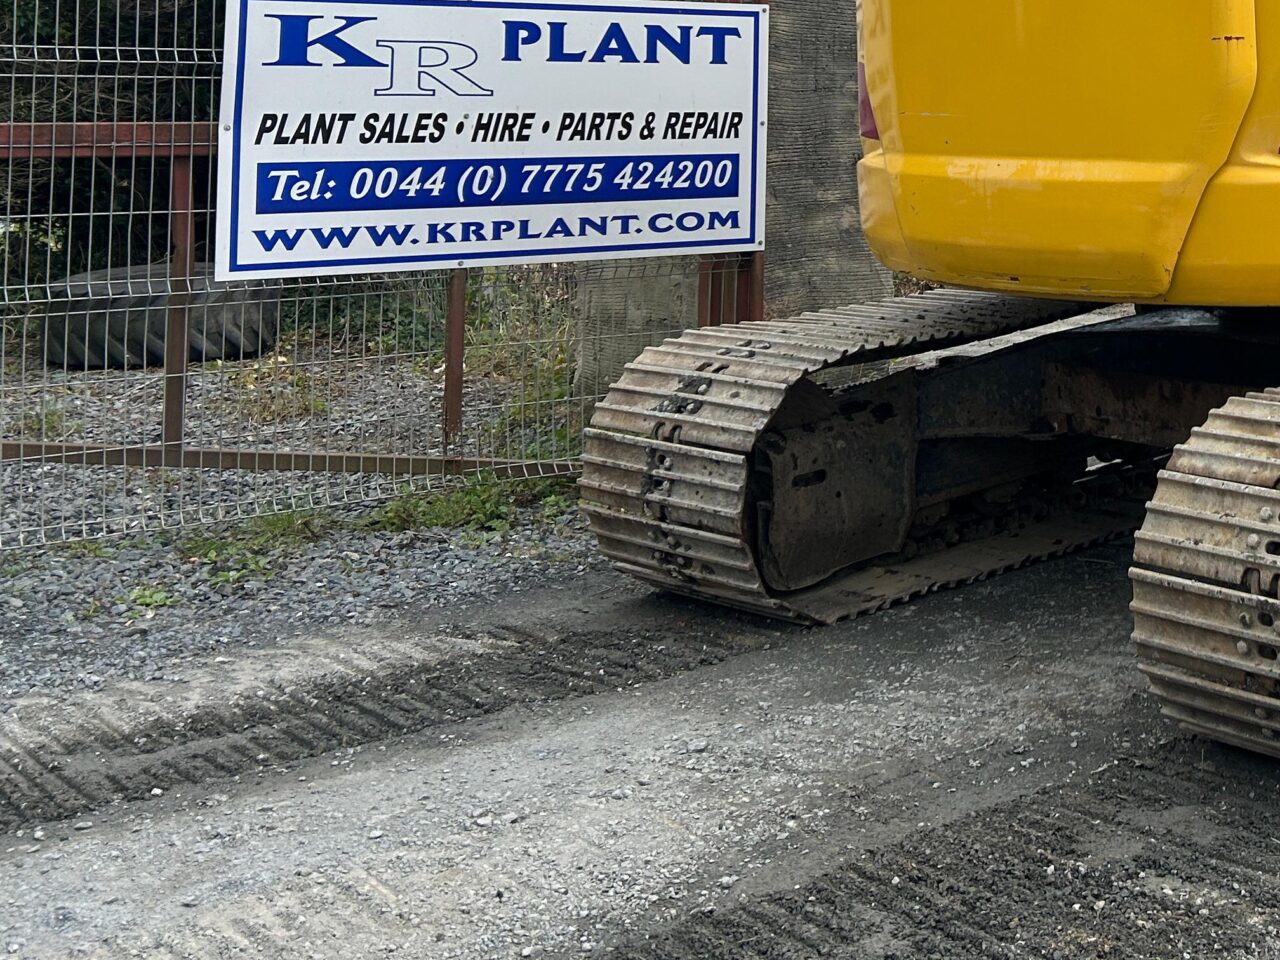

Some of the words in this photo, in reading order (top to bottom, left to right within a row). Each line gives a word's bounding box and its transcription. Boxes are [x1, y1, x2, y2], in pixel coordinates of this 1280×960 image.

[261, 13, 494, 96] KR
[502, 20, 741, 65] PLANT
[254, 113, 355, 145] PLANT
[359, 112, 448, 144] SALES
[471, 112, 536, 143] HIRE
[556, 112, 635, 141] PARTS
[639, 112, 656, 140] &
[662, 112, 743, 140] REPAIR
[267, 168, 336, 202] Tel:
[350, 167, 446, 199] 0044
[457, 165, 507, 202] (0)
[521, 163, 606, 192] 7775
[613, 159, 733, 190] 424200
[253, 210, 740, 252] WWW.KRPLANT.COM
